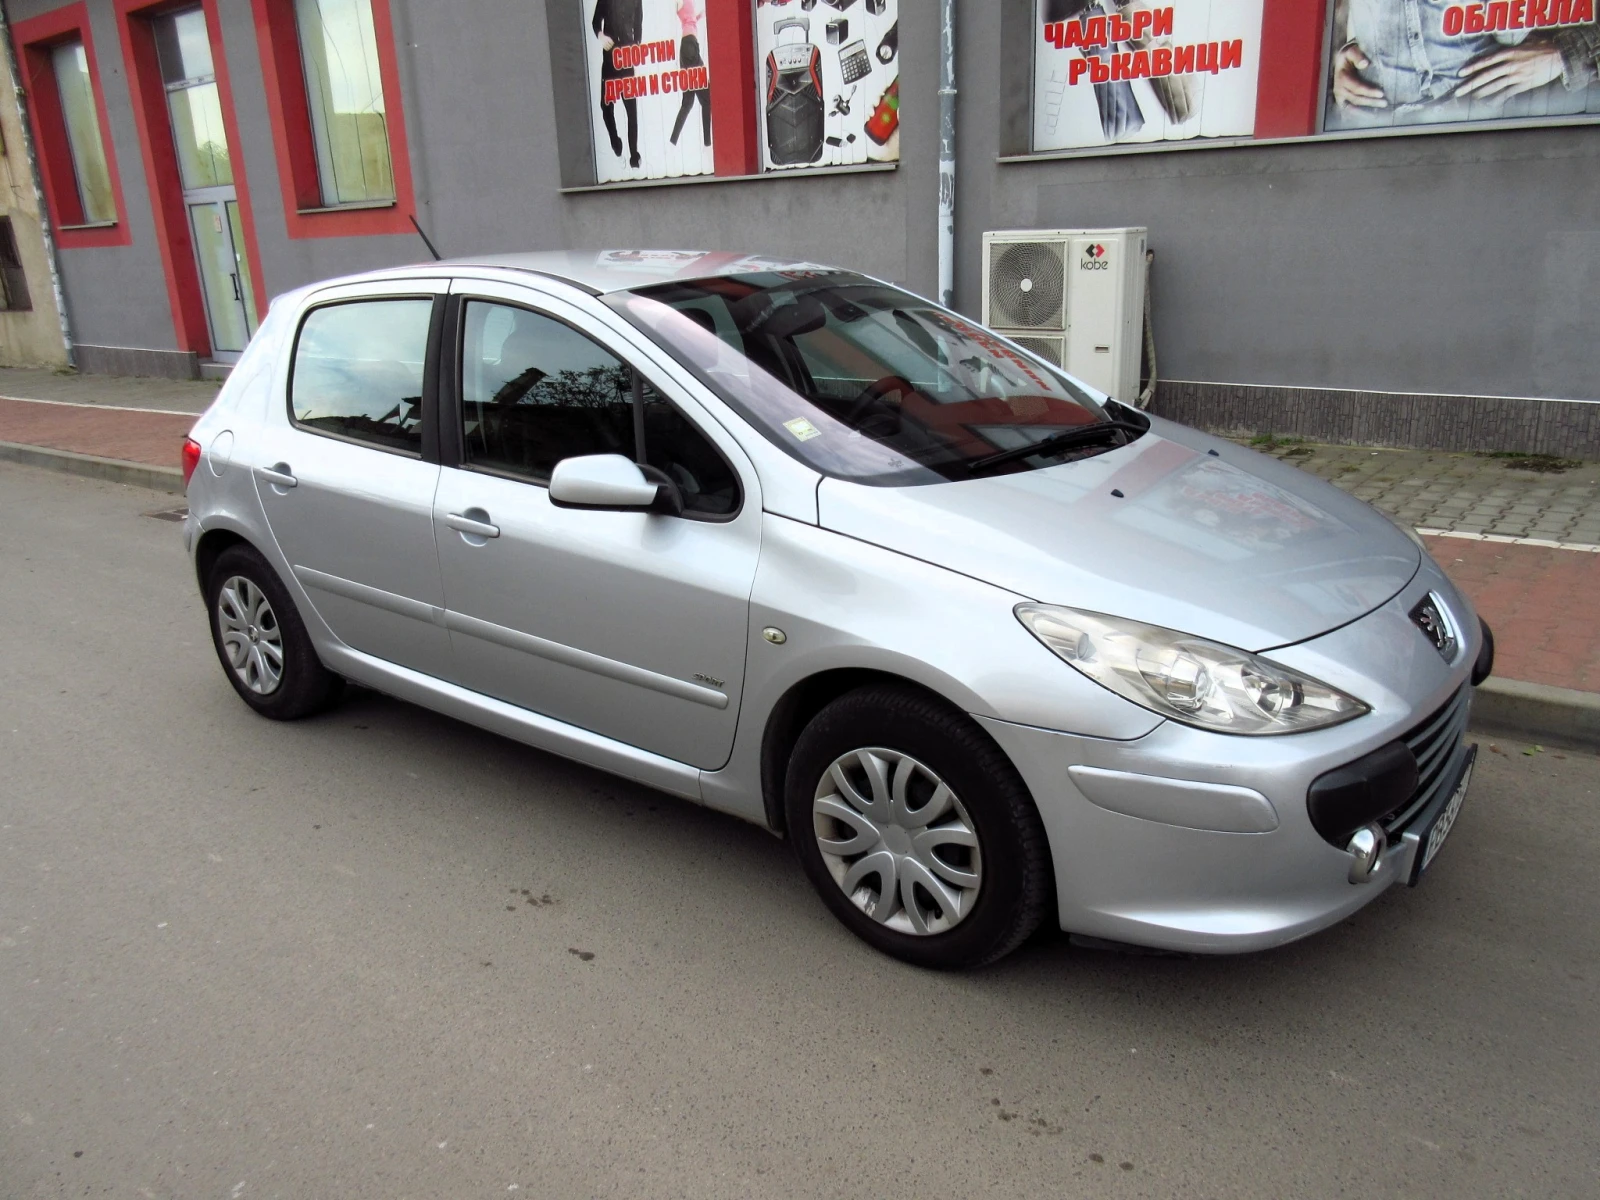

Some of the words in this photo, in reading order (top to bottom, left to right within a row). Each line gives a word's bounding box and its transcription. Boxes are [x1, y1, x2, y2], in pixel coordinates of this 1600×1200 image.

[1044, 7, 1174, 50] ЧАДЪРИ
[1442, 0, 1594, 37] ОБЛЕКЛА
[612, 39, 676, 70] СПОРТНИ
[1069, 39, 1243, 85] РЪКАВИЦИ
[605, 76, 648, 105] ДРЕХИ
[649, 74, 660, 96] И
[661, 67, 708, 94] СТОКИ
[1080, 257, 1109, 271] kobe
